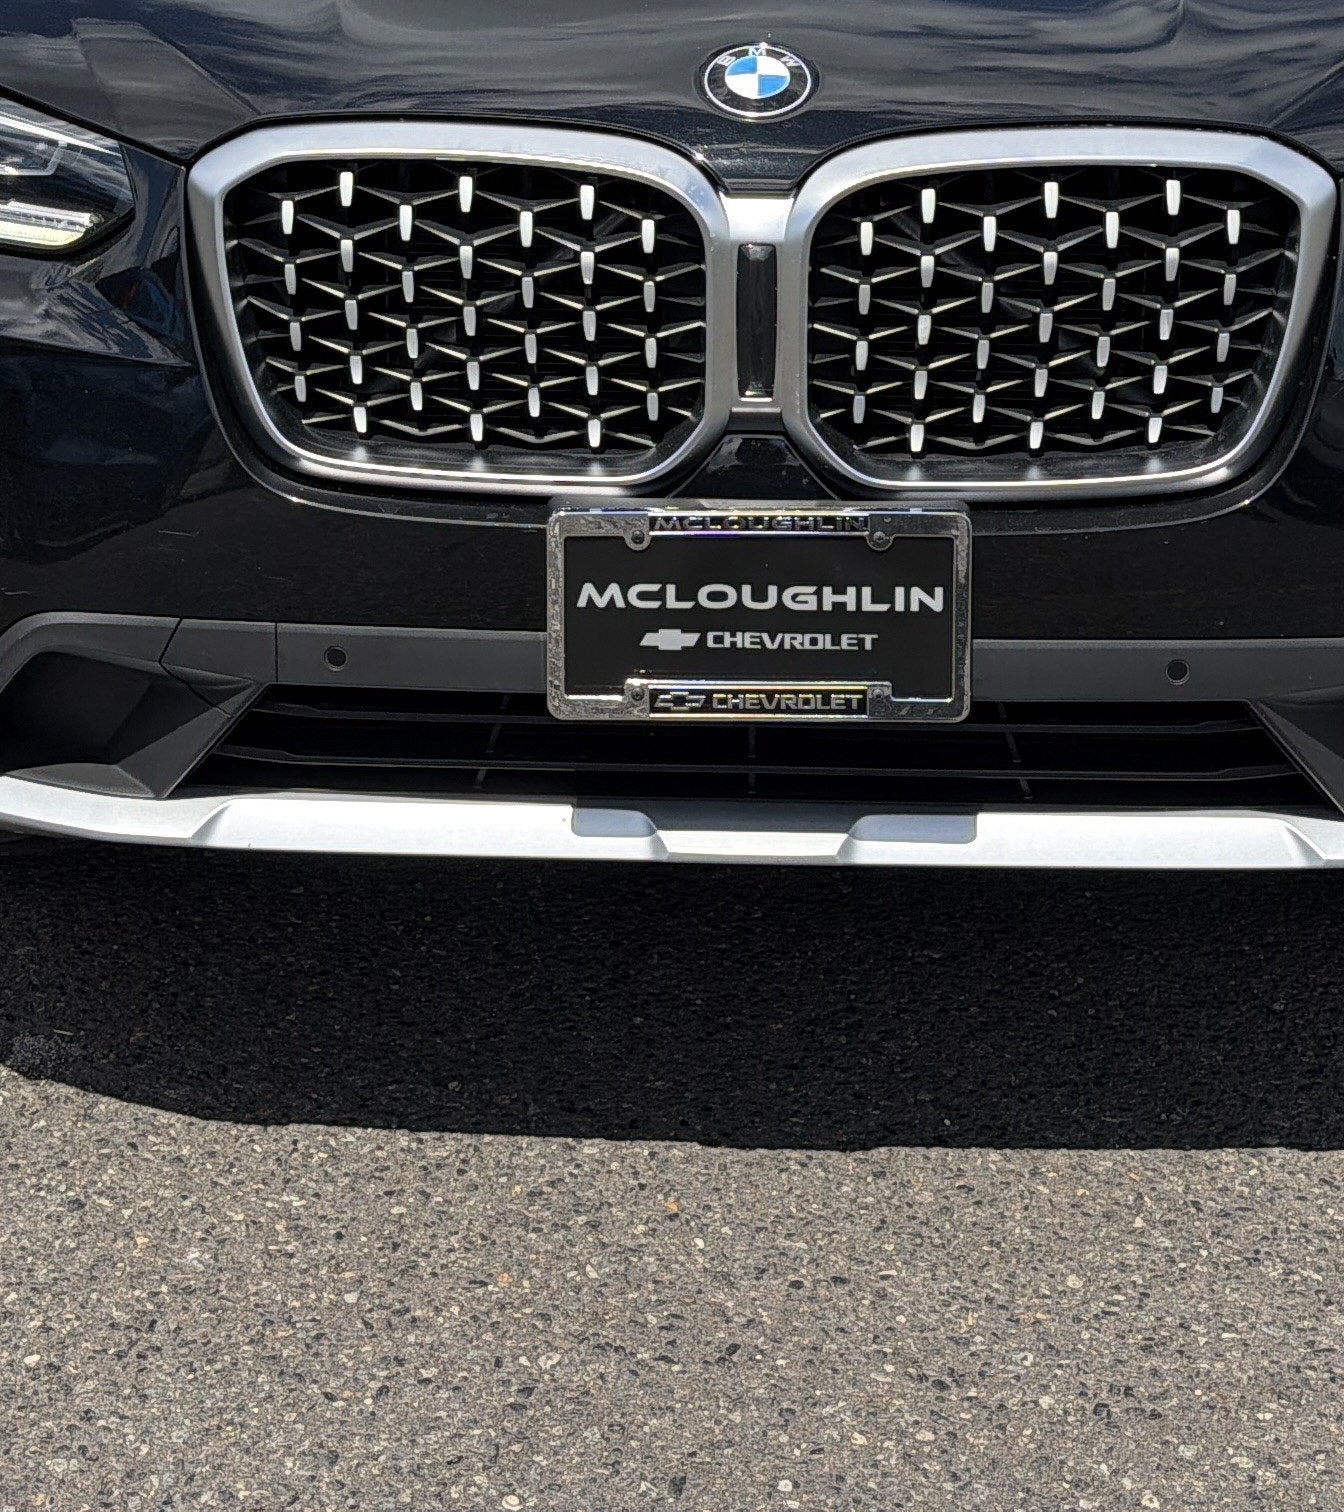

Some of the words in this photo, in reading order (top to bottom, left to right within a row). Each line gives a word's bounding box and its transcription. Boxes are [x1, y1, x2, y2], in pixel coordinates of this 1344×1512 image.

[716, 44, 802, 68] BMW
[655, 515, 869, 531] MCLOUGHLIN
[576, 582, 945, 613] MCLOUGHLIN
[706, 631, 879, 651] CHEVROLET
[712, 693, 864, 710] CHEVROLET
